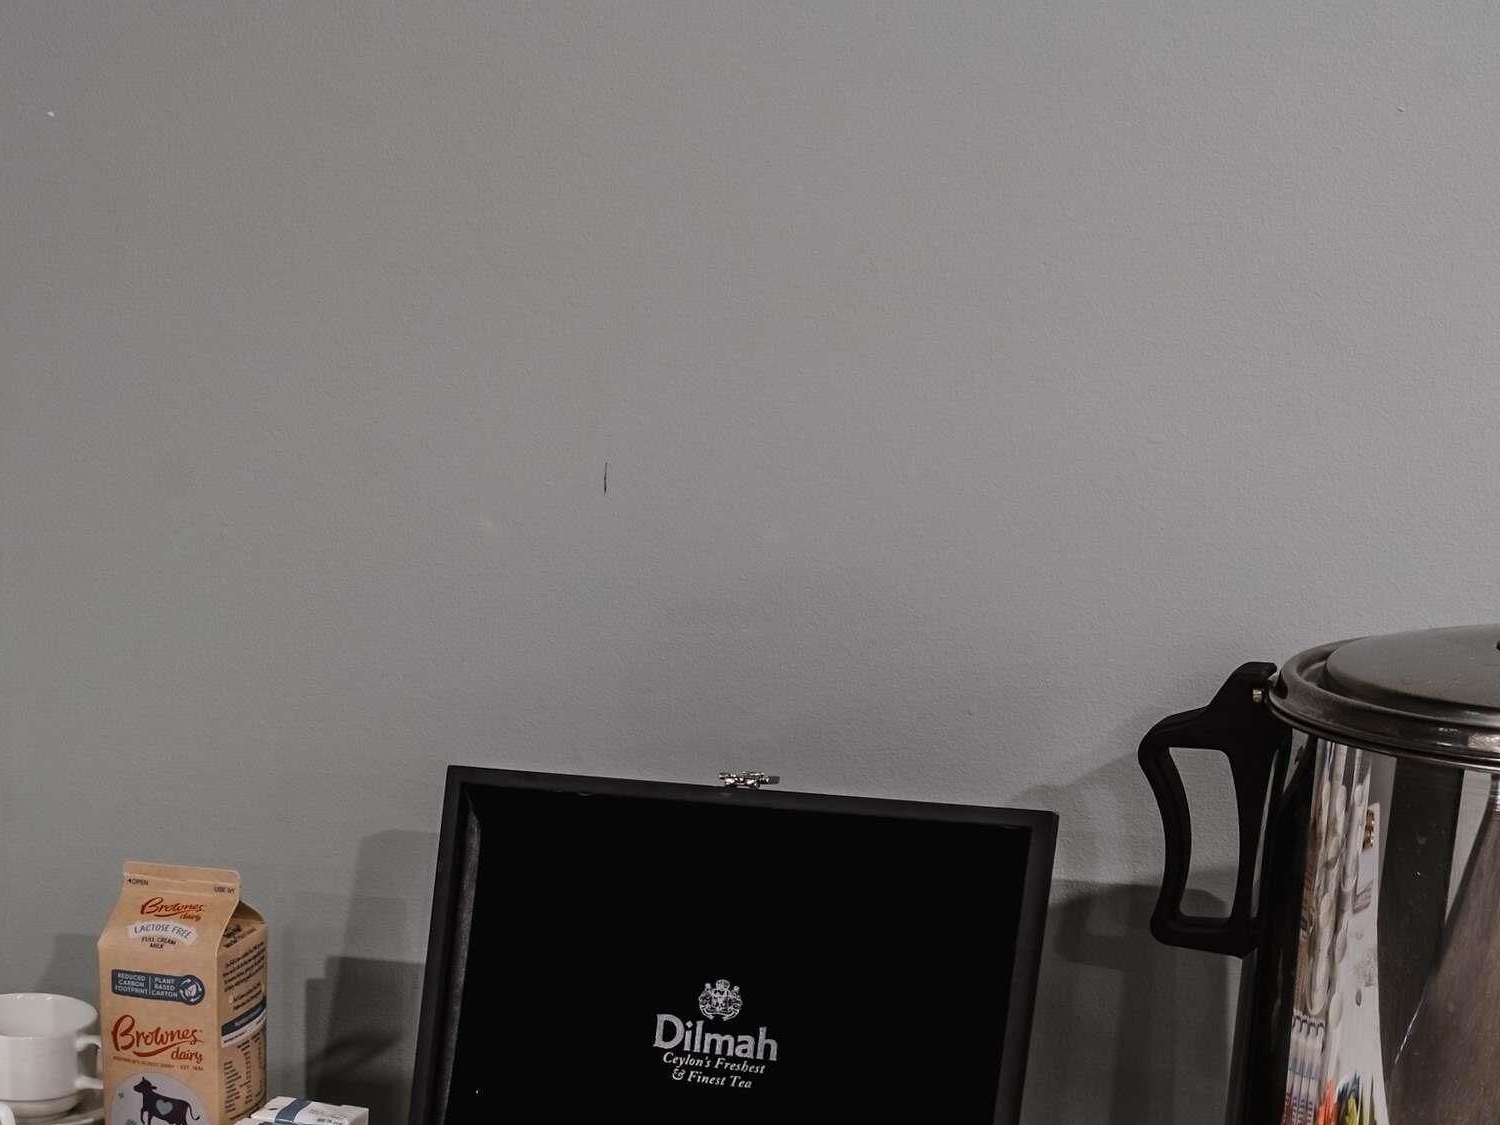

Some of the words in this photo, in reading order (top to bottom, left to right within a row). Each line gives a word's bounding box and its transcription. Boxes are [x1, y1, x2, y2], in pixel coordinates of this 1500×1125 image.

[140, 897, 205, 917] Brownes
[179, 911, 202, 922] dairy
[134, 922, 171, 935] LACTOSE
[172, 925, 194, 940] FREE
[141, 936, 157, 944] FULL
[158, 937, 176, 945] CREAM
[117, 973, 146, 981] REDUCED
[154, 977, 175, 985] PLANT
[118, 979, 145, 988] CARBON
[154, 983, 176, 991] BASED
[115, 985, 149, 995] FOOTPRINT
[152, 990, 178, 998] CARTON
[111, 1014, 203, 1057] Brownes
[653, 1013, 778, 1061] Dilmah
[171, 1046, 203, 1064] dairy
[662, 1051, 711, 1068] Ceylon's
[714, 1057, 766, 1074] Freshest
[672, 1068, 686, 1080] &
[687, 1071, 726, 1086] Finest
[729, 1075, 752, 1088] Tea
